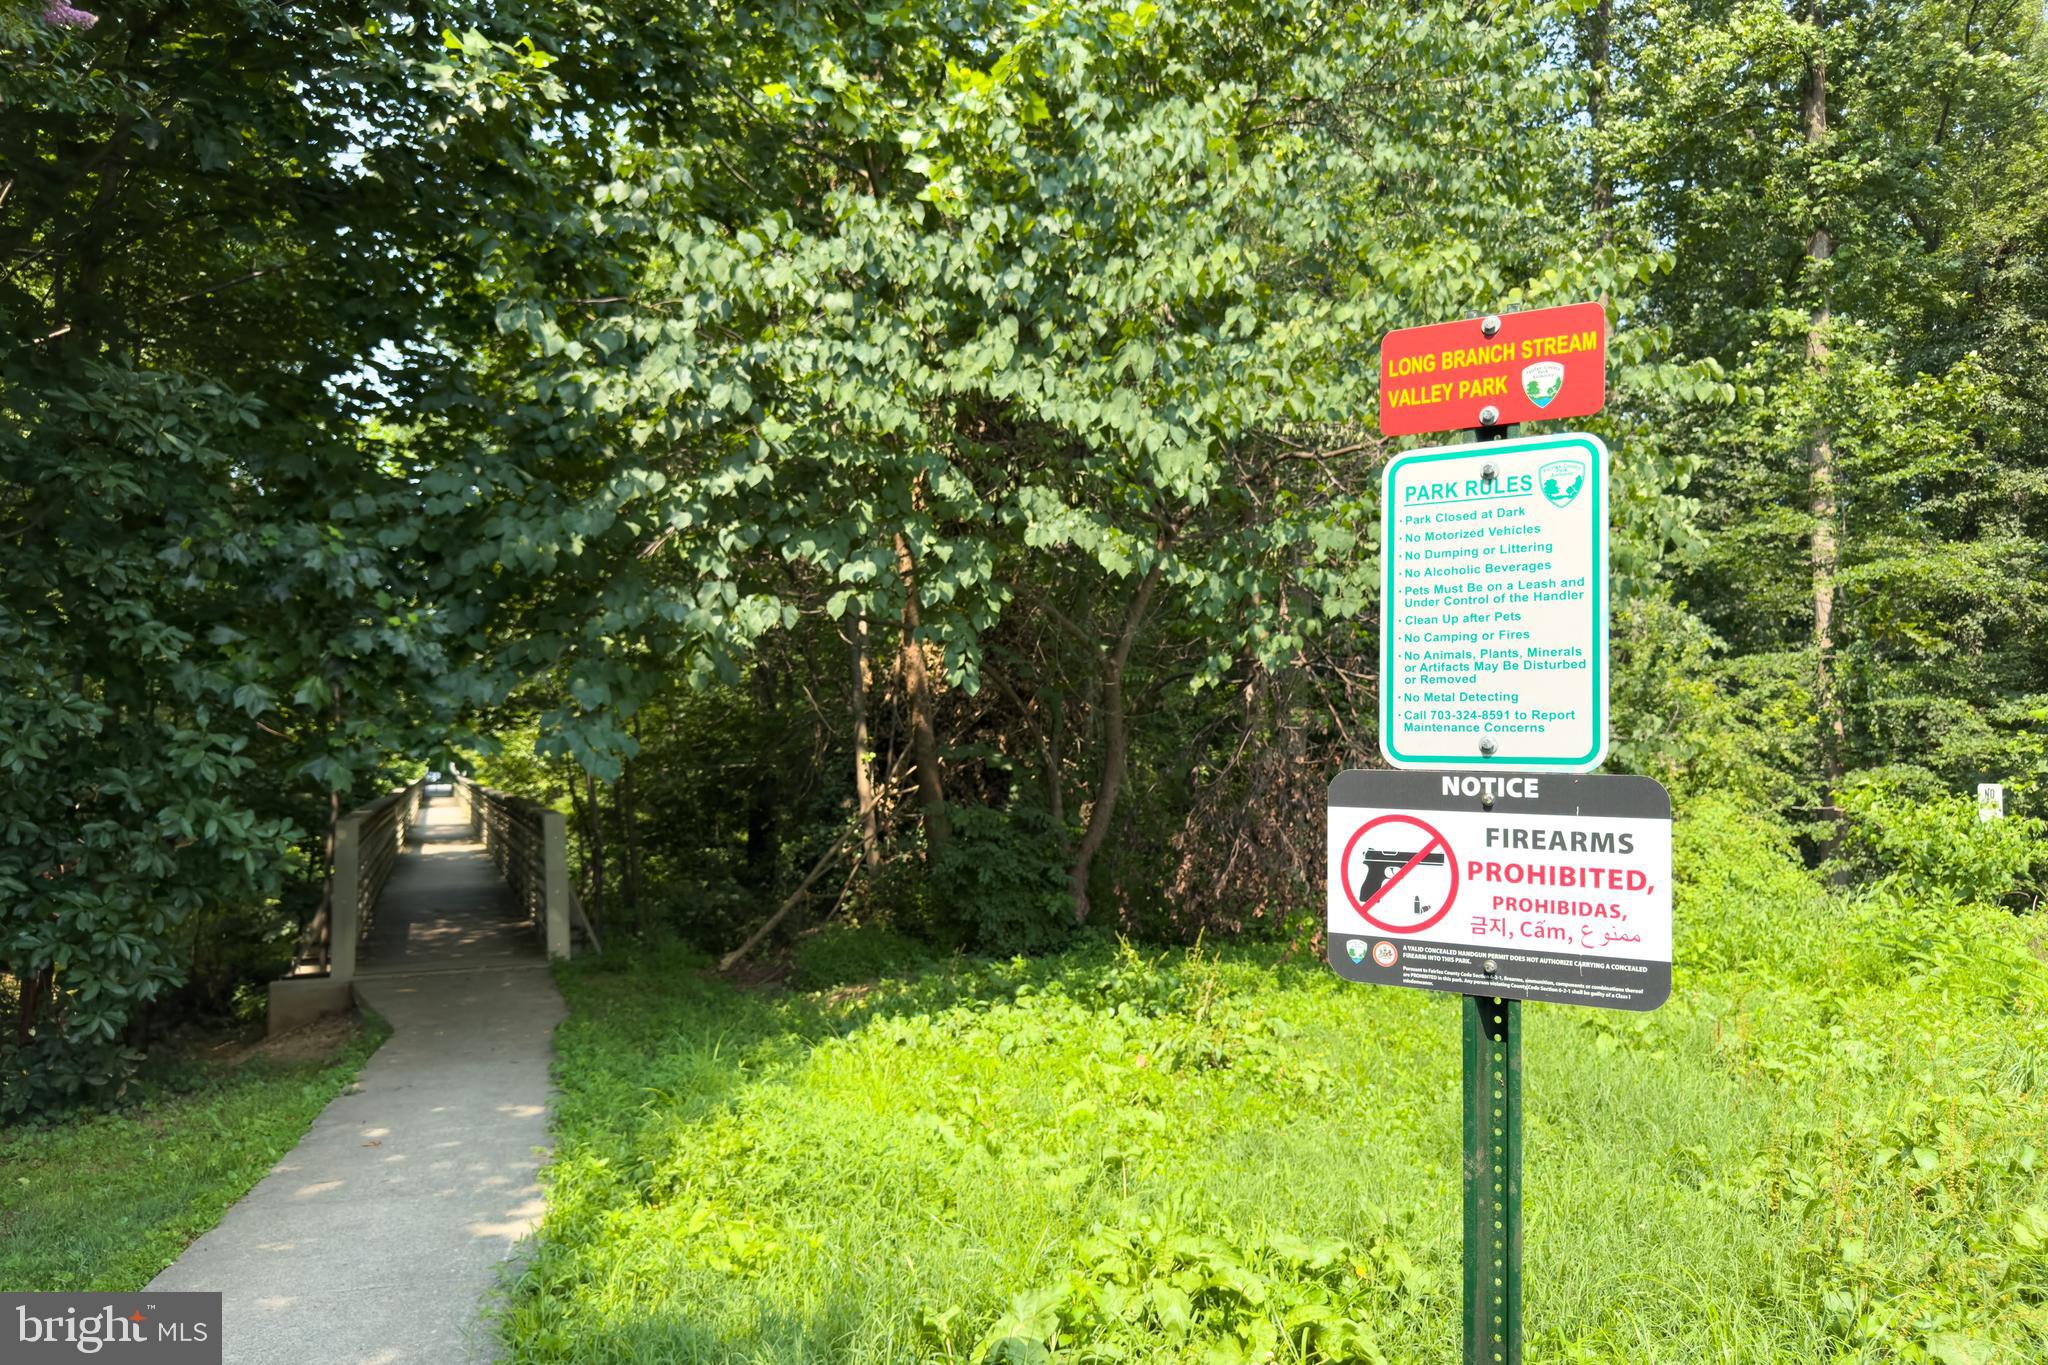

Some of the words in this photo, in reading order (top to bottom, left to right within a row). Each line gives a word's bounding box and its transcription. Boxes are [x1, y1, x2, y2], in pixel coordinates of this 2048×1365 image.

[1389, 354, 1436, 377] LONG
[1442, 342, 1515, 370] BRANCH
[1521, 331, 1597, 359] STREAM
[1388, 383, 1453, 408] VALLEY
[1459, 376, 1508, 399] PARK
[1406, 482, 1457, 501] PARK
[1466, 475, 1532, 496] RULES
[1405, 514, 1431, 525] Park
[1435, 510, 1477, 523] Closed
[1481, 509, 1493, 519] at
[1497, 506, 1525, 518] Dark
[1405, 533, 1421, 543] No
[1424, 527, 1485, 542] Motorized
[1488, 524, 1541, 537] Vehicles
[1405, 551, 1421, 561] No
[1424, 548, 1479, 560] Dumping
[1482, 547, 1496, 556] or
[1499, 542, 1553, 555] Littering
[1404, 568, 1421, 578] No
[1423, 565, 1481, 577] Alcoholic
[1484, 561, 1552, 574] Beverages
[1404, 586, 1430, 596] Pets
[1433, 583, 1463, 595] Must
[1467, 582, 1483, 593] Be
[1486, 583, 1503, 592] on
[1506, 582, 1514, 591] a
[1517, 578, 1557, 590] Leash
[1560, 576, 1585, 588] and
[1404, 597, 1440, 608] Under
[1443, 594, 1489, 607] Control
[1493, 592, 1506, 604] of
[1509, 593, 1529, 603] the
[1533, 590, 1584, 602] Handler
[1405, 615, 1438, 626] Clean
[1442, 614, 1459, 626] Up
[1462, 613, 1490, 624] after
[1494, 611, 1522, 622] Pets
[1404, 633, 1421, 643] No
[1423, 632, 1478, 644] Camping
[1481, 632, 1495, 641] or
[1498, 629, 1530, 640] Fires
[1404, 651, 1421, 661] No
[1423, 649, 1476, 660] Animals,
[1480, 648, 1523, 659] Plants,
[1527, 647, 1582, 658] Minerals
[1404, 665, 1417, 673] or
[1419, 662, 1470, 673] Artifacts
[1473, 661, 1499, 673] May
[1502, 660, 1519, 671] Be
[1523, 659, 1587, 671] Disturbed
[1404, 677, 1417, 685] or
[1420, 674, 1477, 685] Removed
[1403, 692, 1420, 703] No
[1423, 692, 1455, 702] Metal
[1459, 691, 1519, 705] Detecting
[1403, 710, 1427, 721] Call
[1430, 709, 1510, 721] 703-324-8591
[1514, 710, 1528, 721] to
[1531, 709, 1575, 722] Report
[1403, 722, 1480, 733] Maintenance
[1483, 721, 1545, 733] Concerns
[1442, 776, 1539, 798] NOTICE
[1487, 828, 1633, 854] FIREARMS
[1468, 861, 1654, 895] PROHIBITED,
[1493, 896, 1626, 921] PROHIBIDAS,
[1470, 916, 1514, 939] 금지,
[1403, 952, 1427, 960] FIREARM
[1455, 957, 1472, 965] PARK.
[1425, 947, 1457, 955] CONCEALED
[1458, 950, 1487, 958] HANDGUN
[1540, 957, 1573, 966] AUTHORIZE
[1573, 960, 1605, 969] CARRYING
[1611, 963, 1648, 973] CONCEALED
